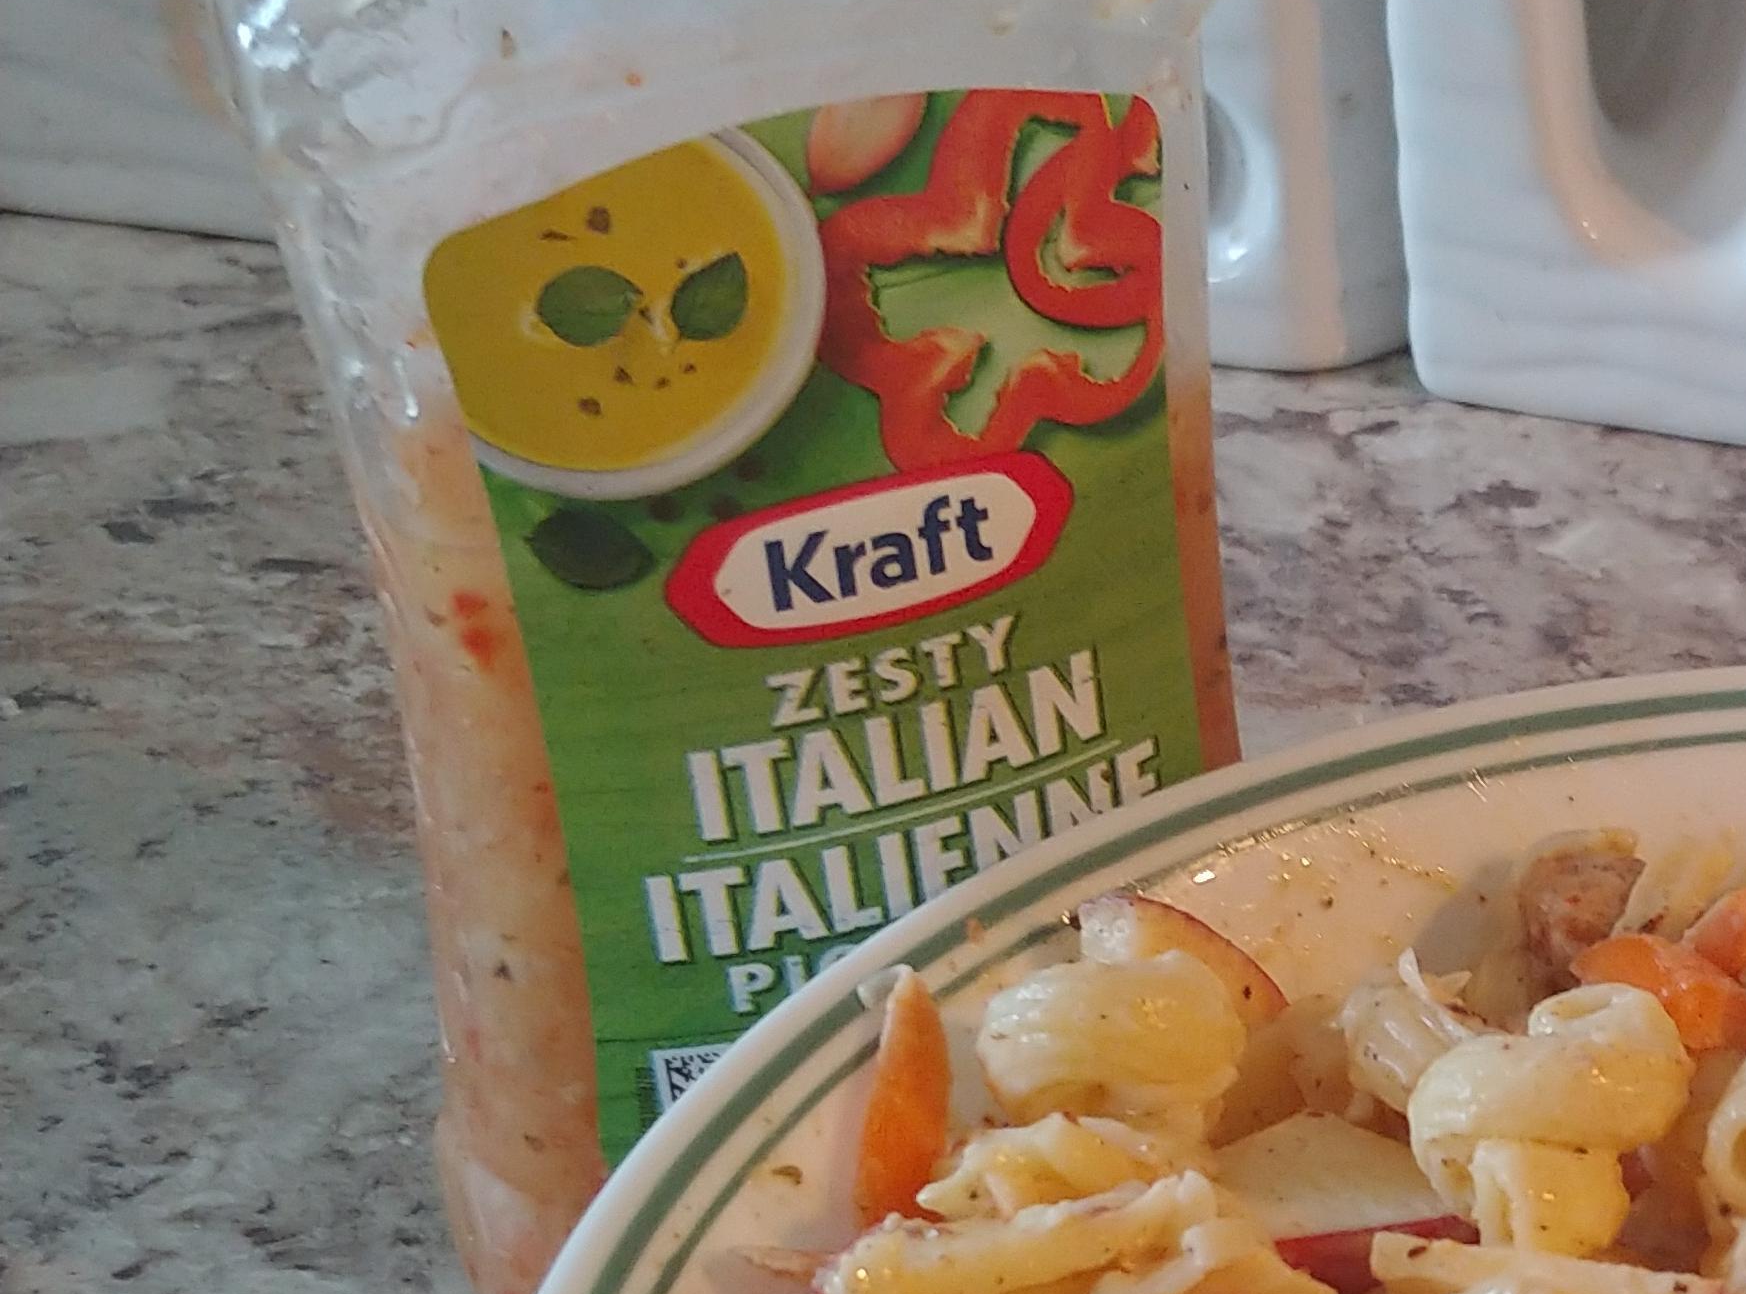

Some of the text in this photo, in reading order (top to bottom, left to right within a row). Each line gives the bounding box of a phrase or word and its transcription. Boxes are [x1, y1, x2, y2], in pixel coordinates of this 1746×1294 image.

[765, 496, 993, 611] Kraft
[767, 616, 1015, 726] ZESTY
[688, 650, 1104, 842] ITALIAN
